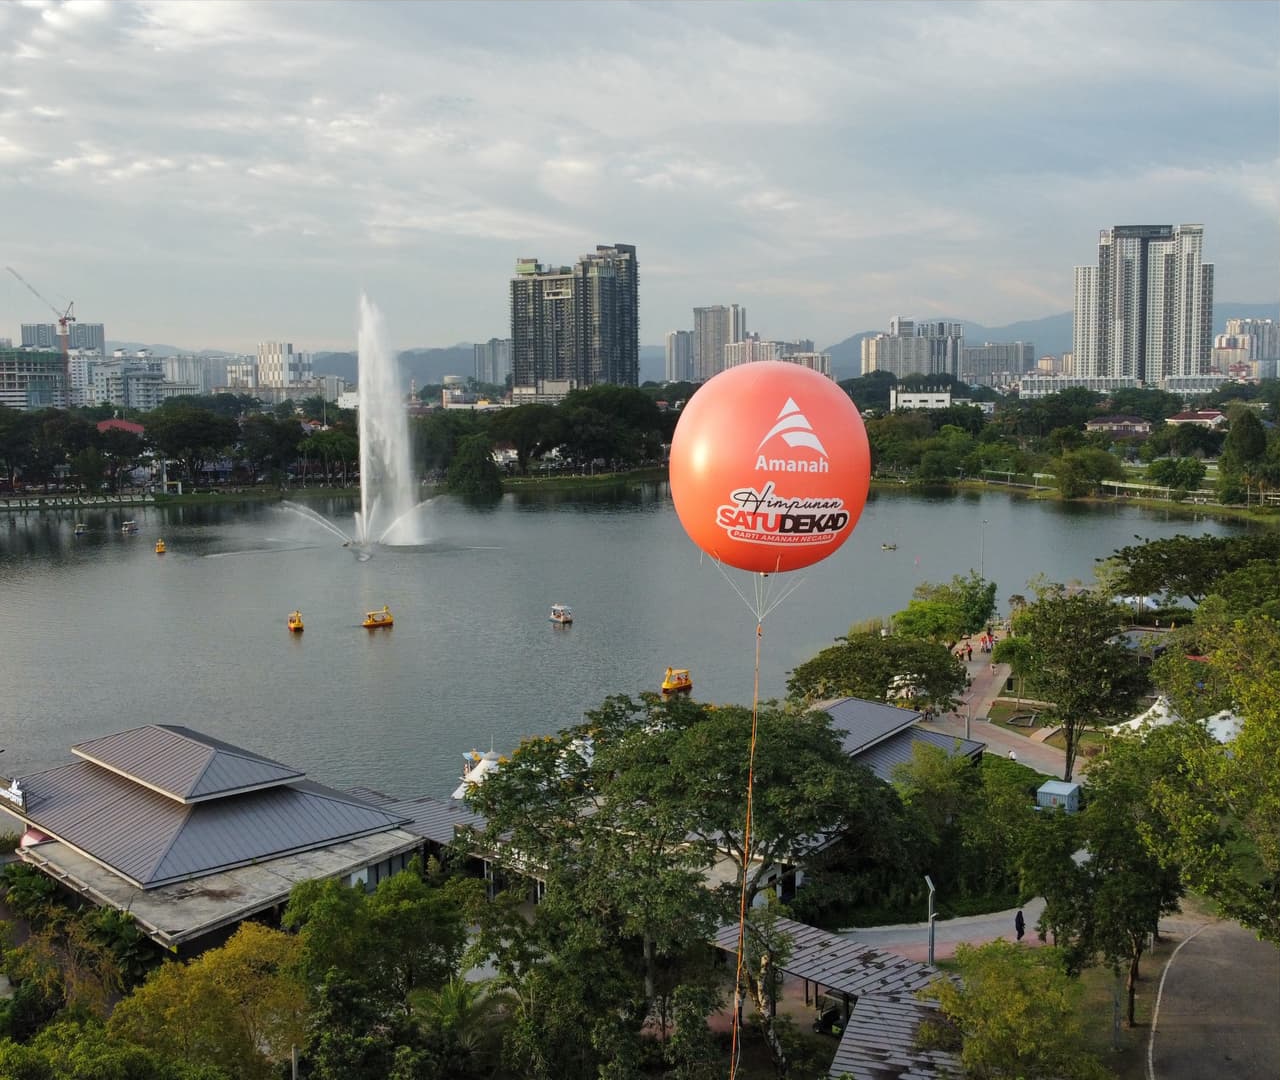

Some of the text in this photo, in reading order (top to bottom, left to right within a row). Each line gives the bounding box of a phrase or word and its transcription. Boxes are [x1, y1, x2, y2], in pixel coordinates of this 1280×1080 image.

[755, 455, 829, 473] Amanah
[733, 485, 841, 516] Himpunan
[734, 530, 759, 540] PARTI
[760, 533, 799, 543] AMANAH
